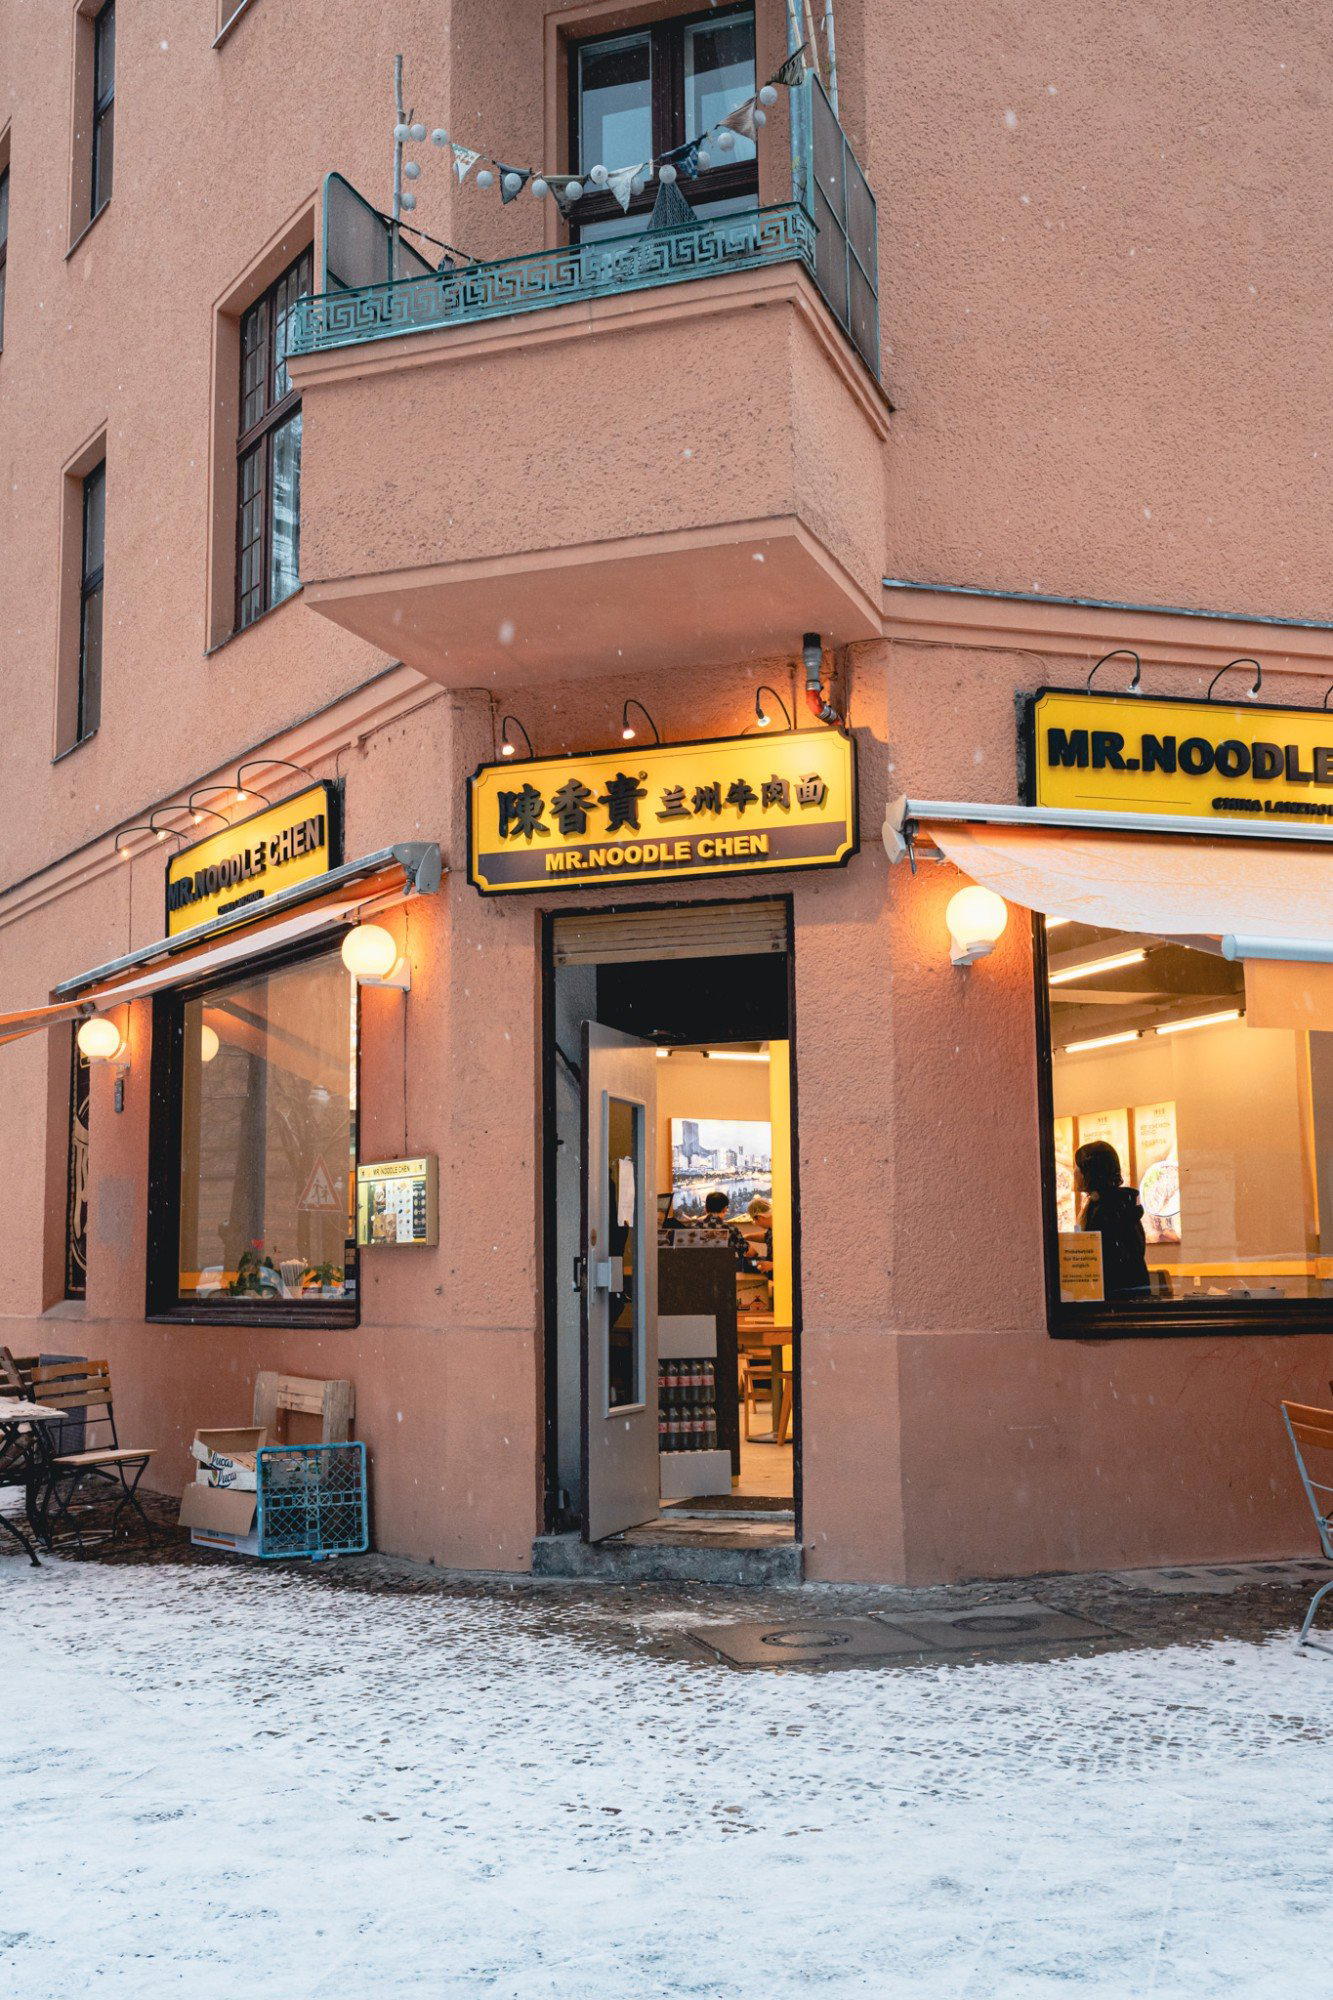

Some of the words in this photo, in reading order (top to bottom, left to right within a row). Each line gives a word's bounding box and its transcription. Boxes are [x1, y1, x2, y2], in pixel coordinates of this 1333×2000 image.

[1048, 728, 1333, 784] MR.NOODLE
[496, 772, 648, 840] 陳香貴
[655, 772, 829, 820] 兰州牛肉面
[167, 842, 266, 911] MR.NOODLE
[269, 814, 325, 866] CHEN
[545, 841, 691, 871] MR.NOODLE
[697, 834, 769, 859] CHEN
